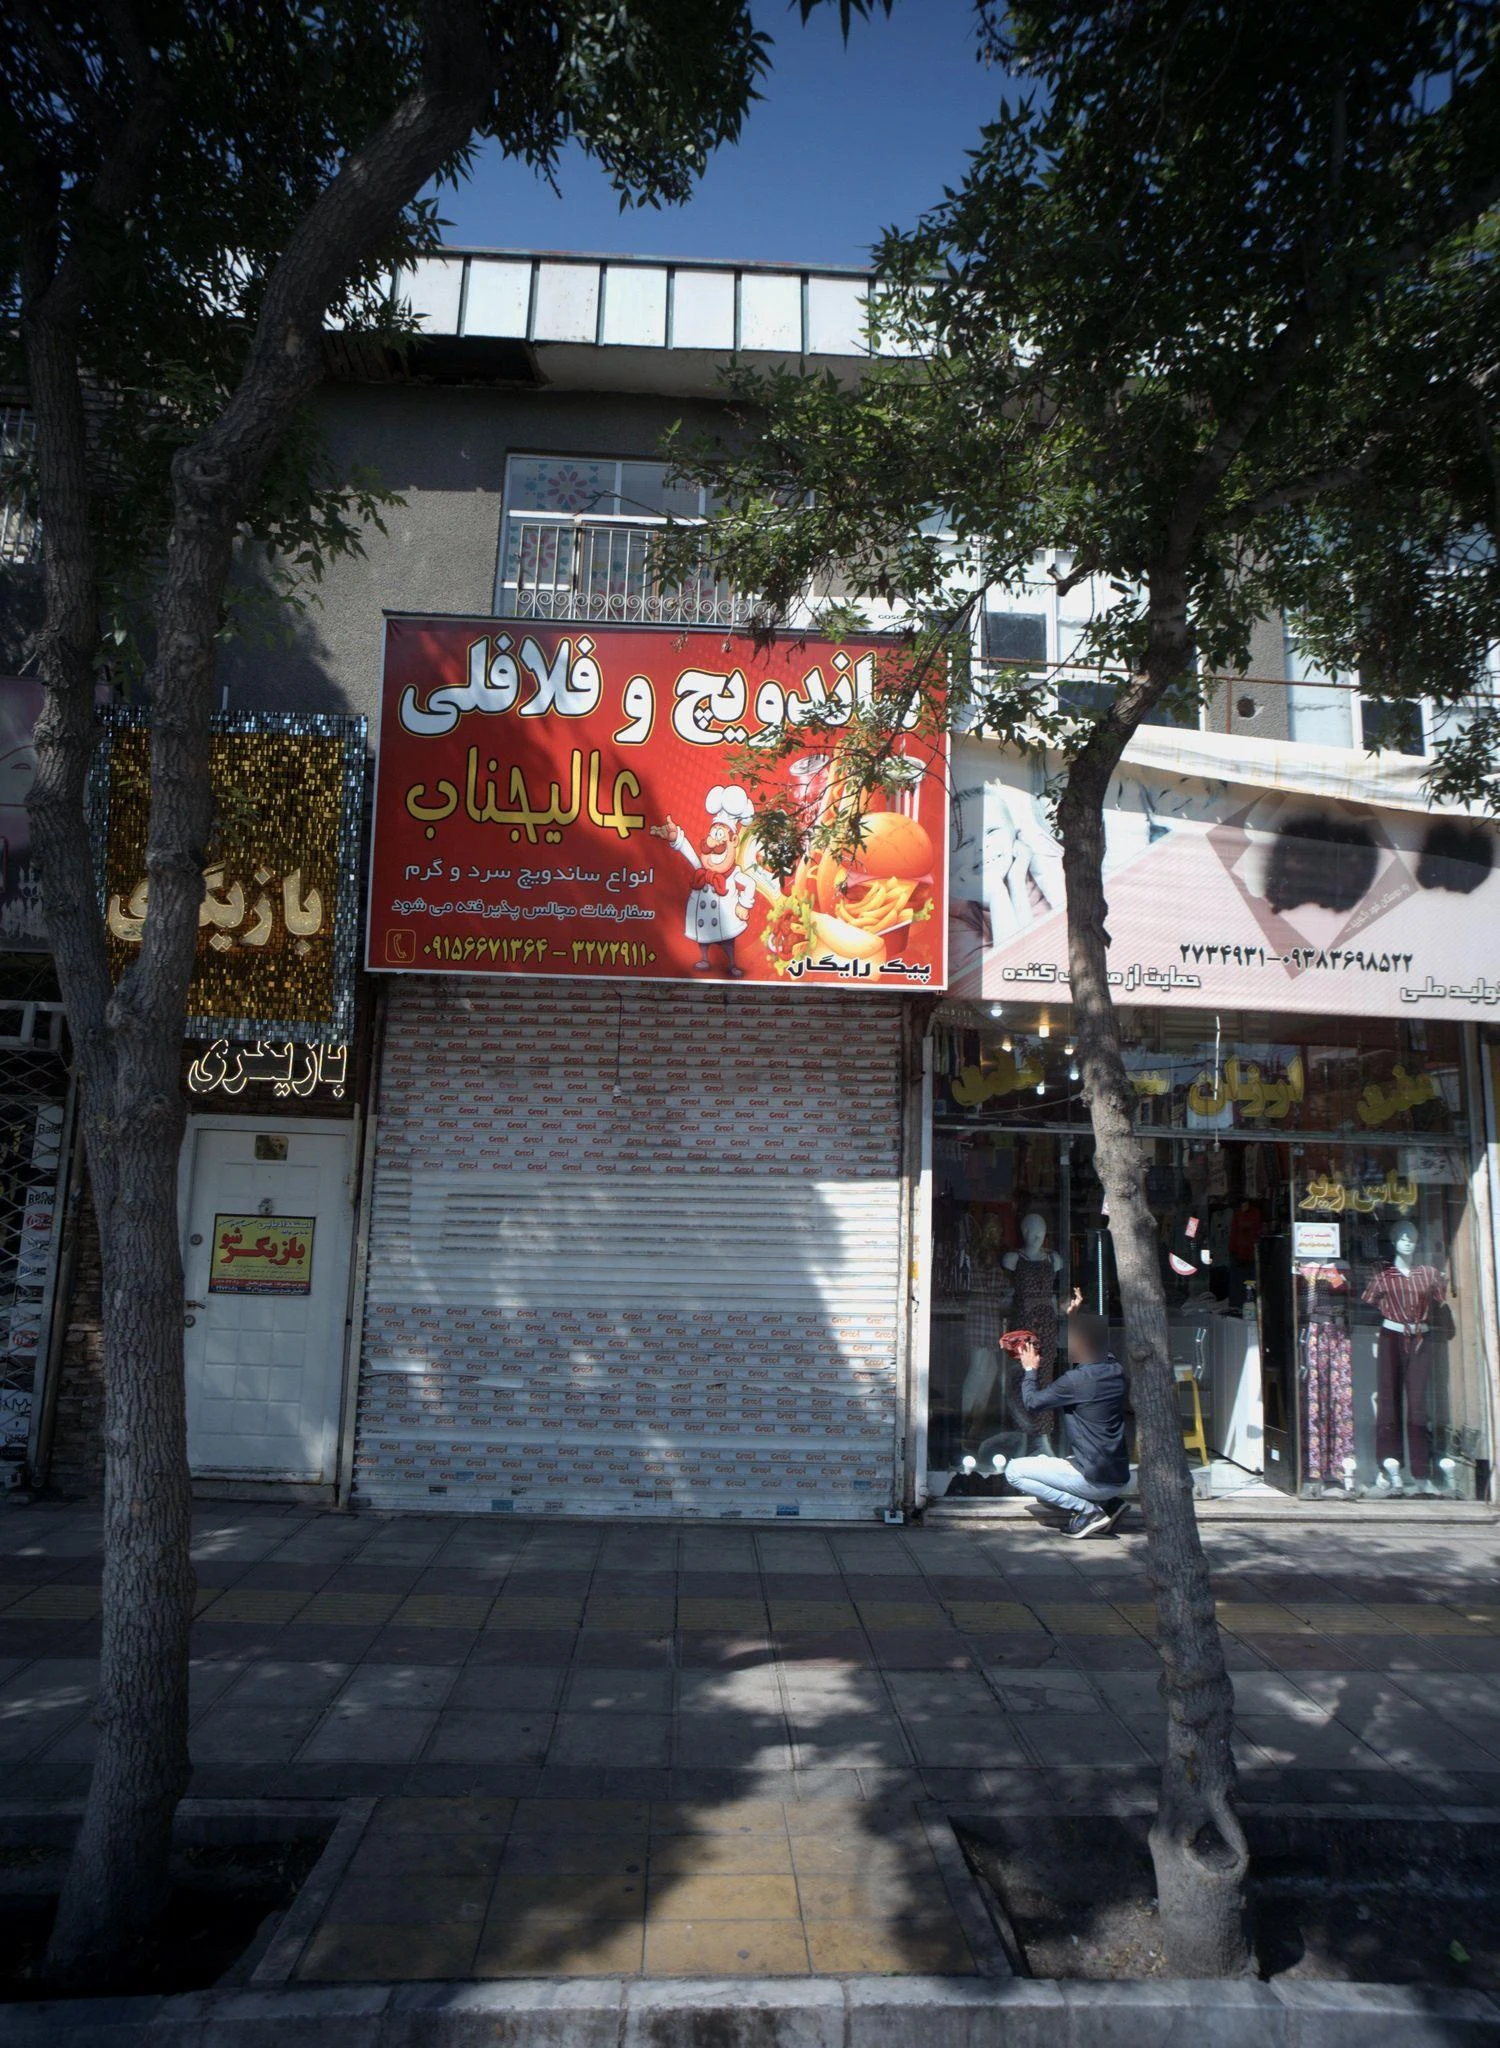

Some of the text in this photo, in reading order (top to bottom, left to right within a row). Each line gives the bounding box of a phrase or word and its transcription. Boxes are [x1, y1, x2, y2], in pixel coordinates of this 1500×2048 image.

[398, 632, 600, 738] فلافلی
[613, 674, 654, 745] و
[404, 745, 645, 844] عالیجناب
[405, 858, 655, 892] انواع ساندویچ سرد و گرم
[108, 860, 322, 956] بازیگی
[391, 896, 655, 921] سفارشات مجالس پذیرفته می شود
[423, 935, 548, 963] ۰۹۱۵۶۶۷۱۳۶۴
[572, 938, 656, 967] ۳۲۷۲۹۱۱۰
[787, 954, 931, 983] پیک رایگان
[1002, 963, 1057, 982] کننده
[1126, 964, 1141, 989] از
[1143, 965, 1201, 991] حمایت
[1400, 976, 1500, 1004] ولید ملی
